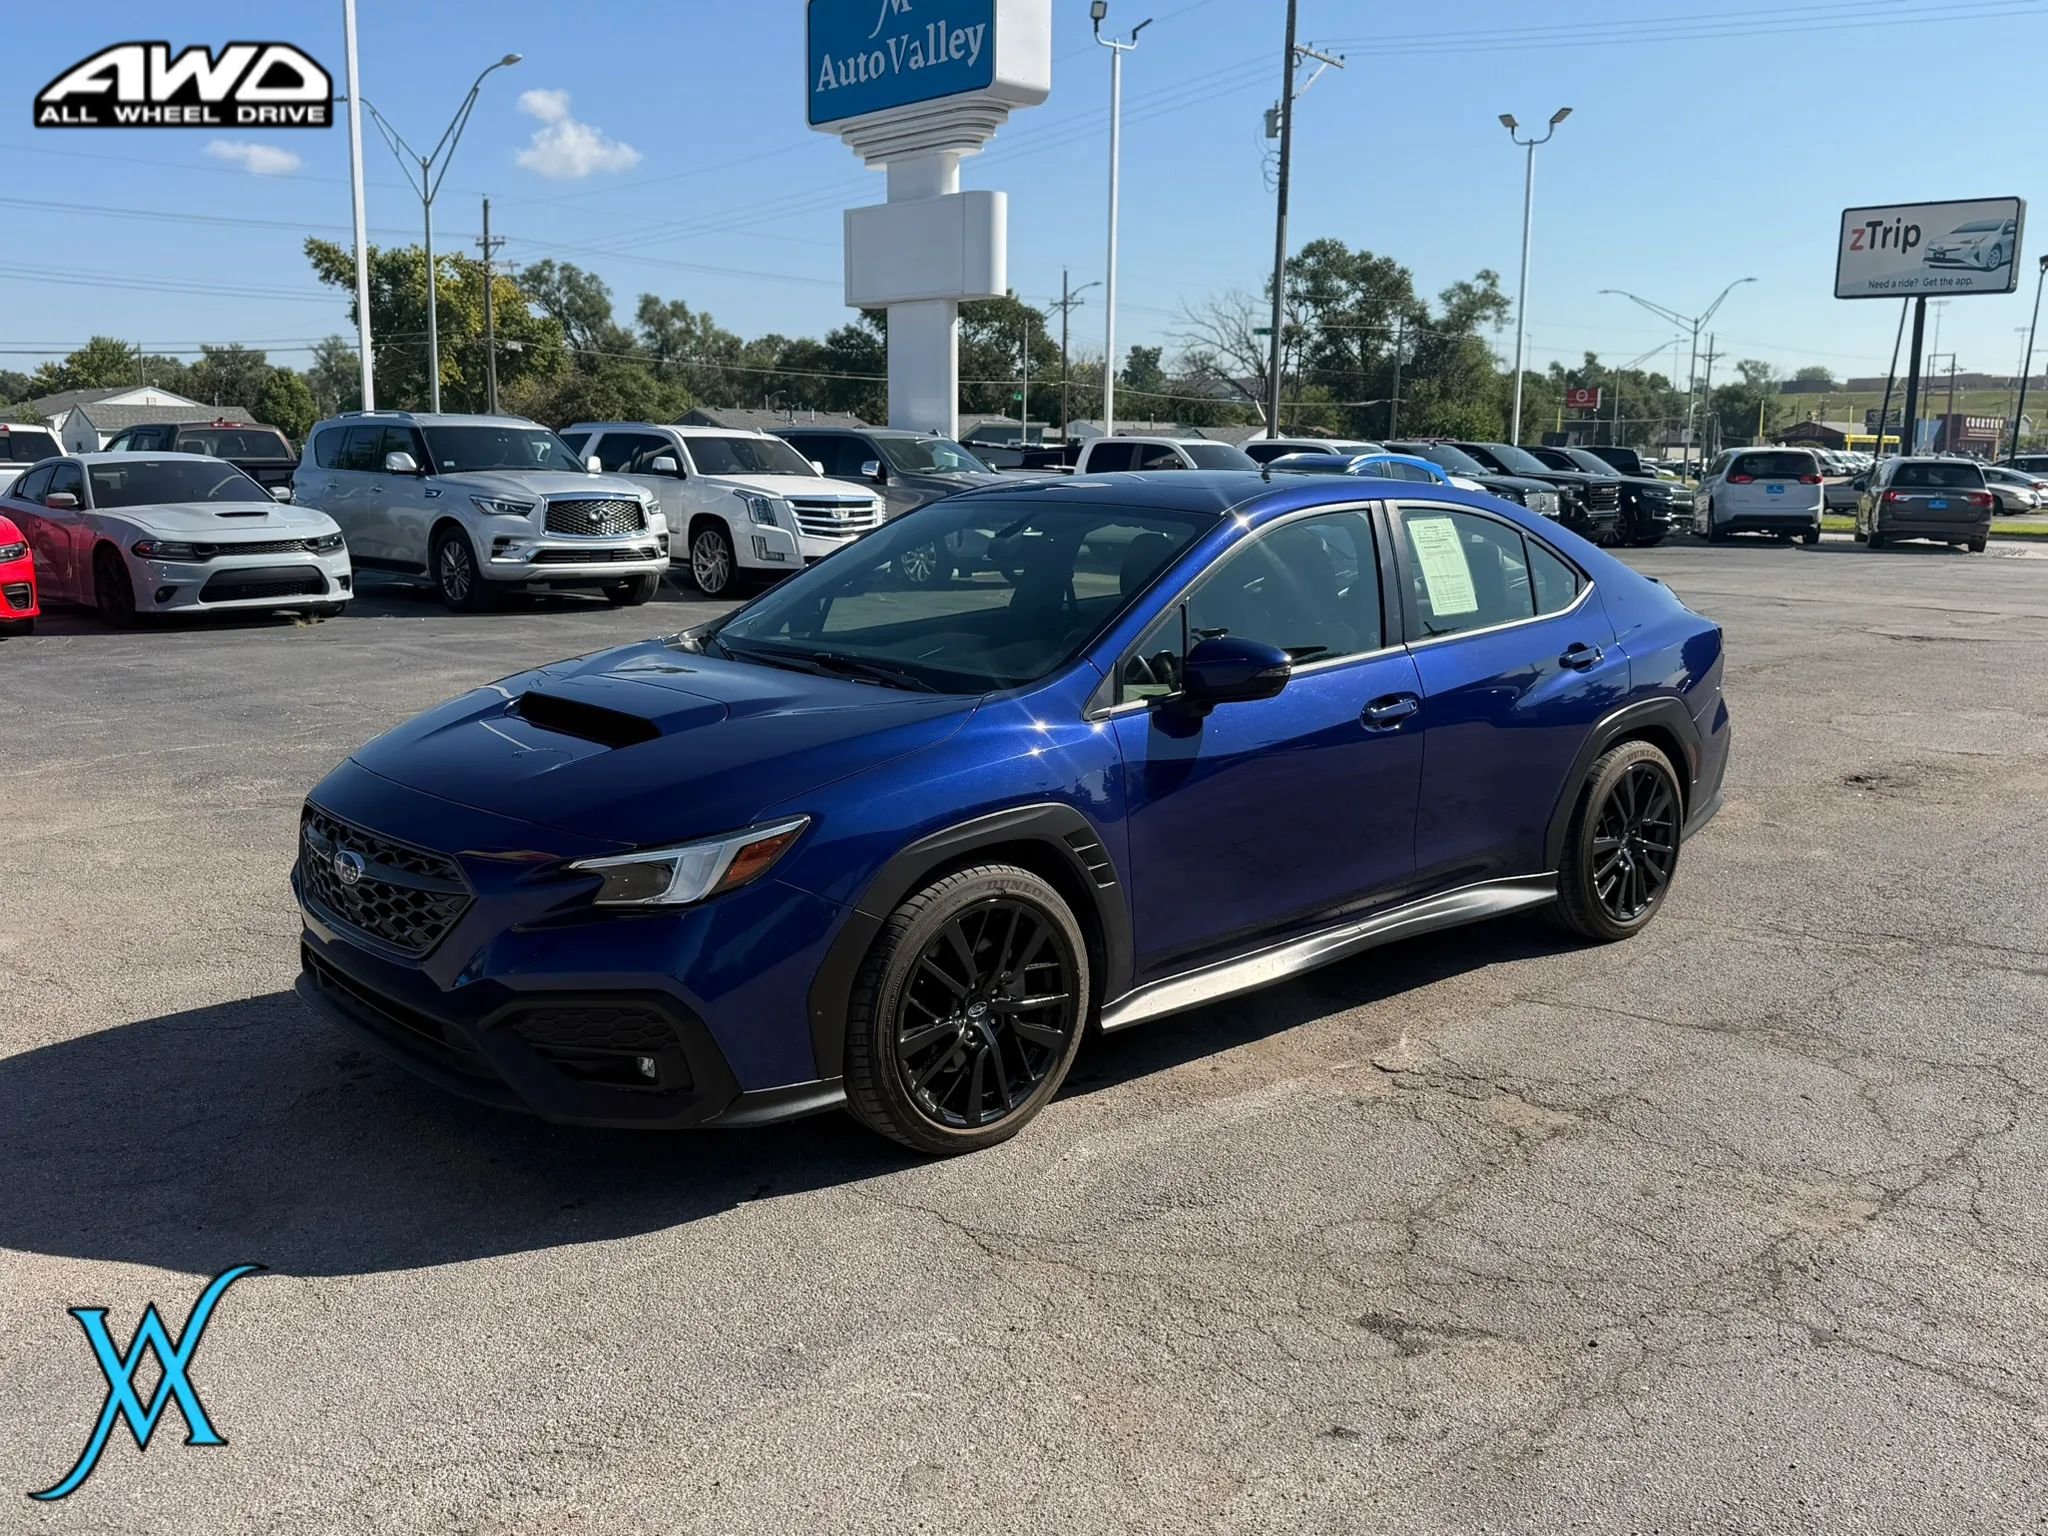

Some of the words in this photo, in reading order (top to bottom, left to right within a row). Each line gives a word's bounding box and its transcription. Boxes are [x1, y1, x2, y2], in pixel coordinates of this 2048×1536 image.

[1849, 217, 1921, 254] zTrip
[1868, 279, 1890, 289] Need
[1898, 278, 1918, 288] ride?
[1923, 277, 1939, 287] Get
[1940, 276, 1954, 286] the
[1955, 278, 1974, 287] app.
[1965, 417, 2004, 429] COURTESY
